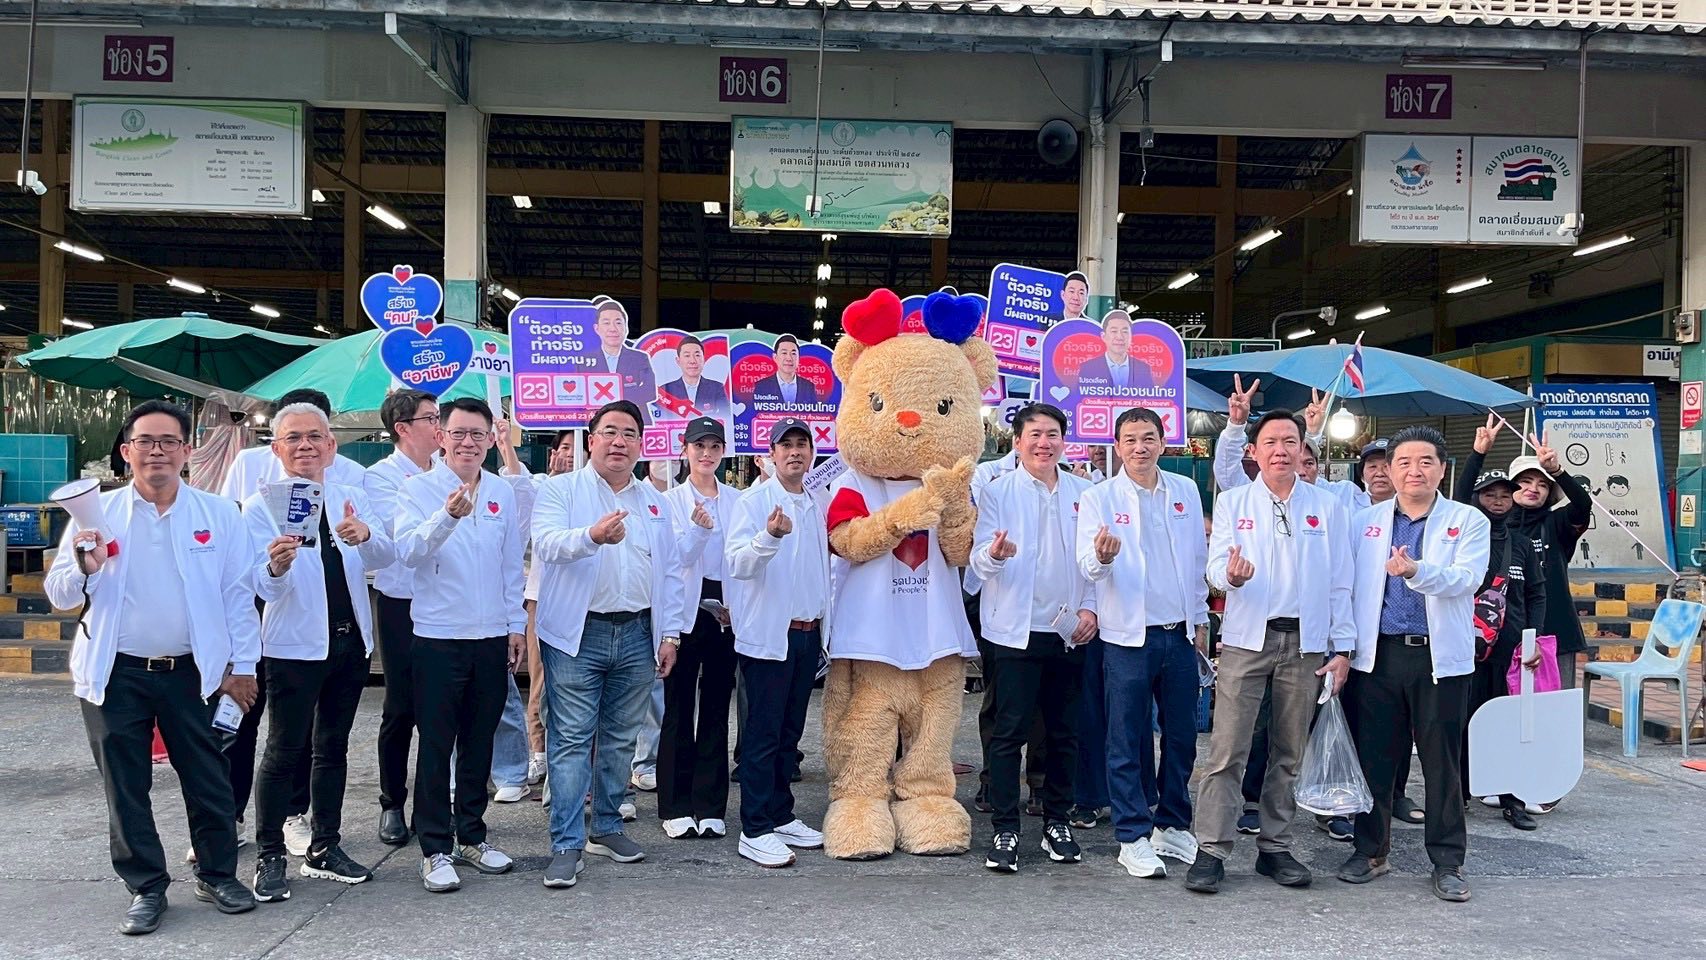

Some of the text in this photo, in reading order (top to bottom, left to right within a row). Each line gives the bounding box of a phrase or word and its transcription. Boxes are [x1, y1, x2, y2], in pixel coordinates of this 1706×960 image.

[107, 40, 168, 76] ช่อง 5
[723, 61, 782, 97] ช่อง 6
[1390, 79, 1448, 113] ช่อง 7
[1485, 144, 1571, 178] สมาคมตลาดสดไทย
[388, 297, 414, 308] สร้าง
[1006, 293, 1049, 312] ทำจริง
[531, 336, 584, 351] ทำจริง
[991, 332, 1014, 349] 23
[414, 350, 444, 364] สร้าง
[403, 363, 459, 383] “อาชีพ”
[522, 382, 549, 400] 23
[1079, 385, 1176, 397] พรรคปวงชนไทย
[1540, 389, 1649, 404] ทางเข้าอาคารตลาด
[754, 401, 836, 412] พรรคปวงชนไทย
[1082, 412, 1107, 429] 23
[757, 426, 773, 441] 2
[646, 436, 667, 450] 23
[1115, 513, 1130, 524] 23
[1237, 519, 1254, 530] 23
[1364, 526, 1381, 537] 23
